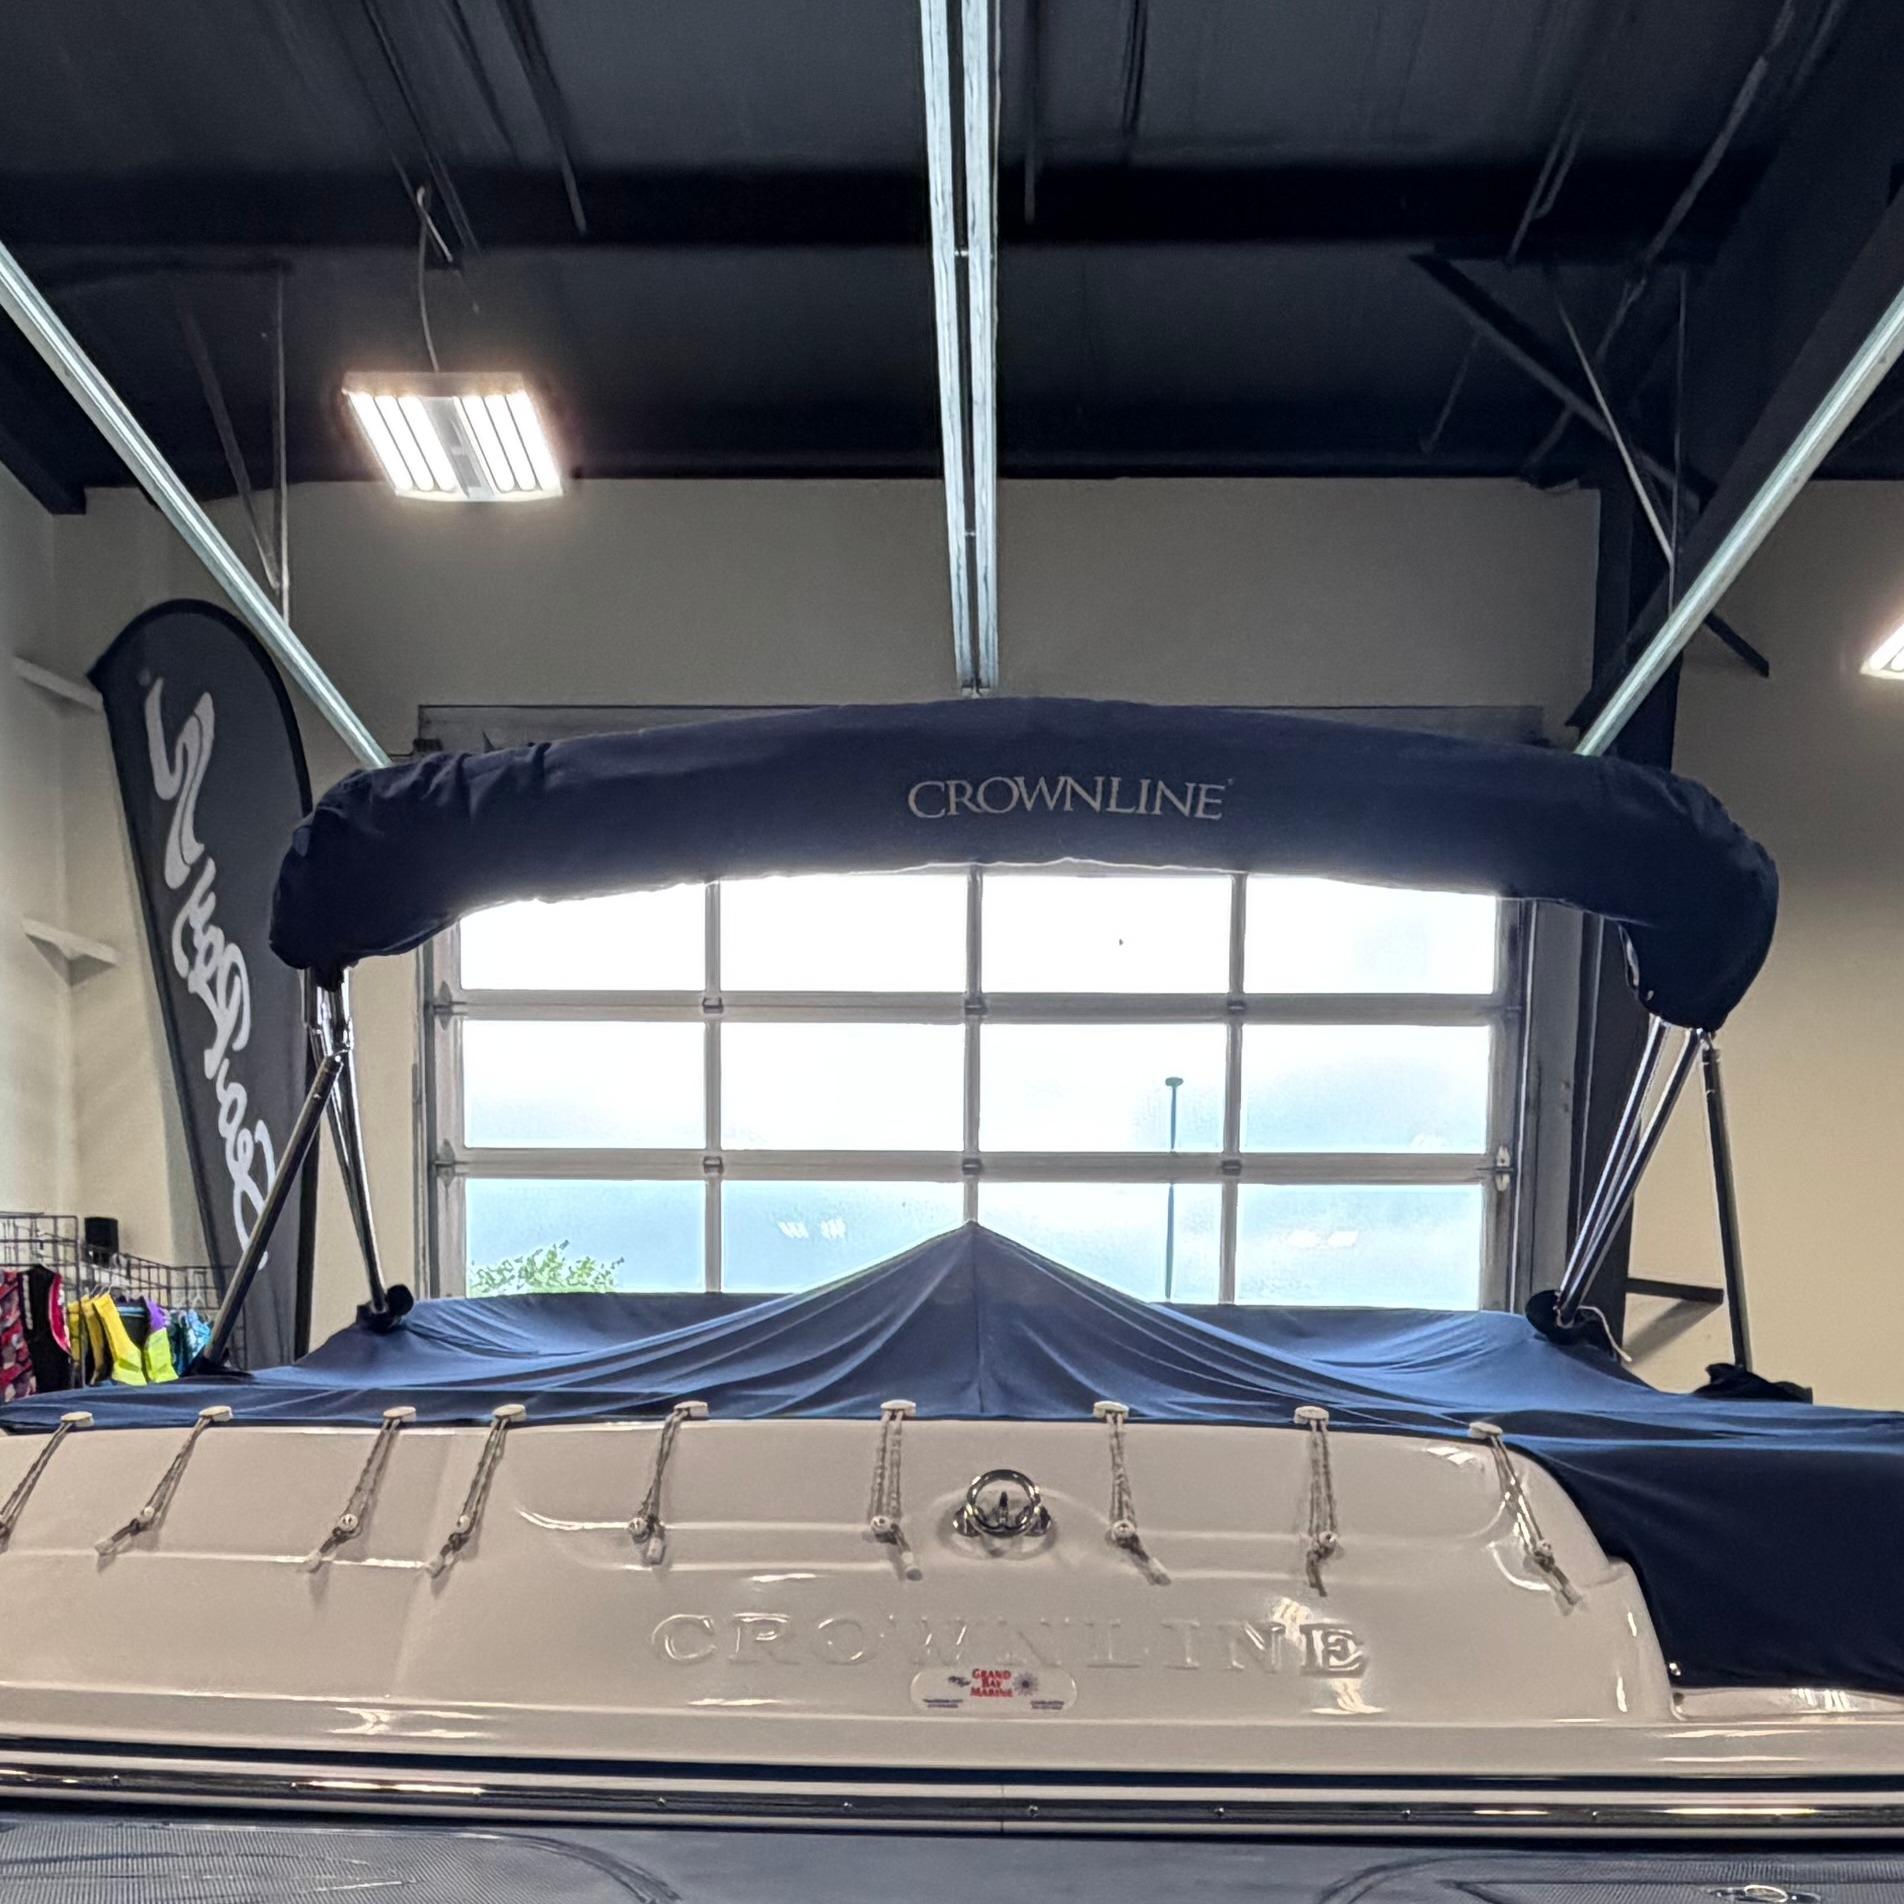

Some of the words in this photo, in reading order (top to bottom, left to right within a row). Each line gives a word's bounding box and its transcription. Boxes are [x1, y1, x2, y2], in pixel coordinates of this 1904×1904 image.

[908, 775, 1227, 821] CROWNLINE
[649, 1611, 1369, 1678] CROWNLINE
[971, 1668, 1012, 1680] GRAND
[982, 1678, 1002, 1688] BAY
[970, 1687, 1013, 1698] MARINE
